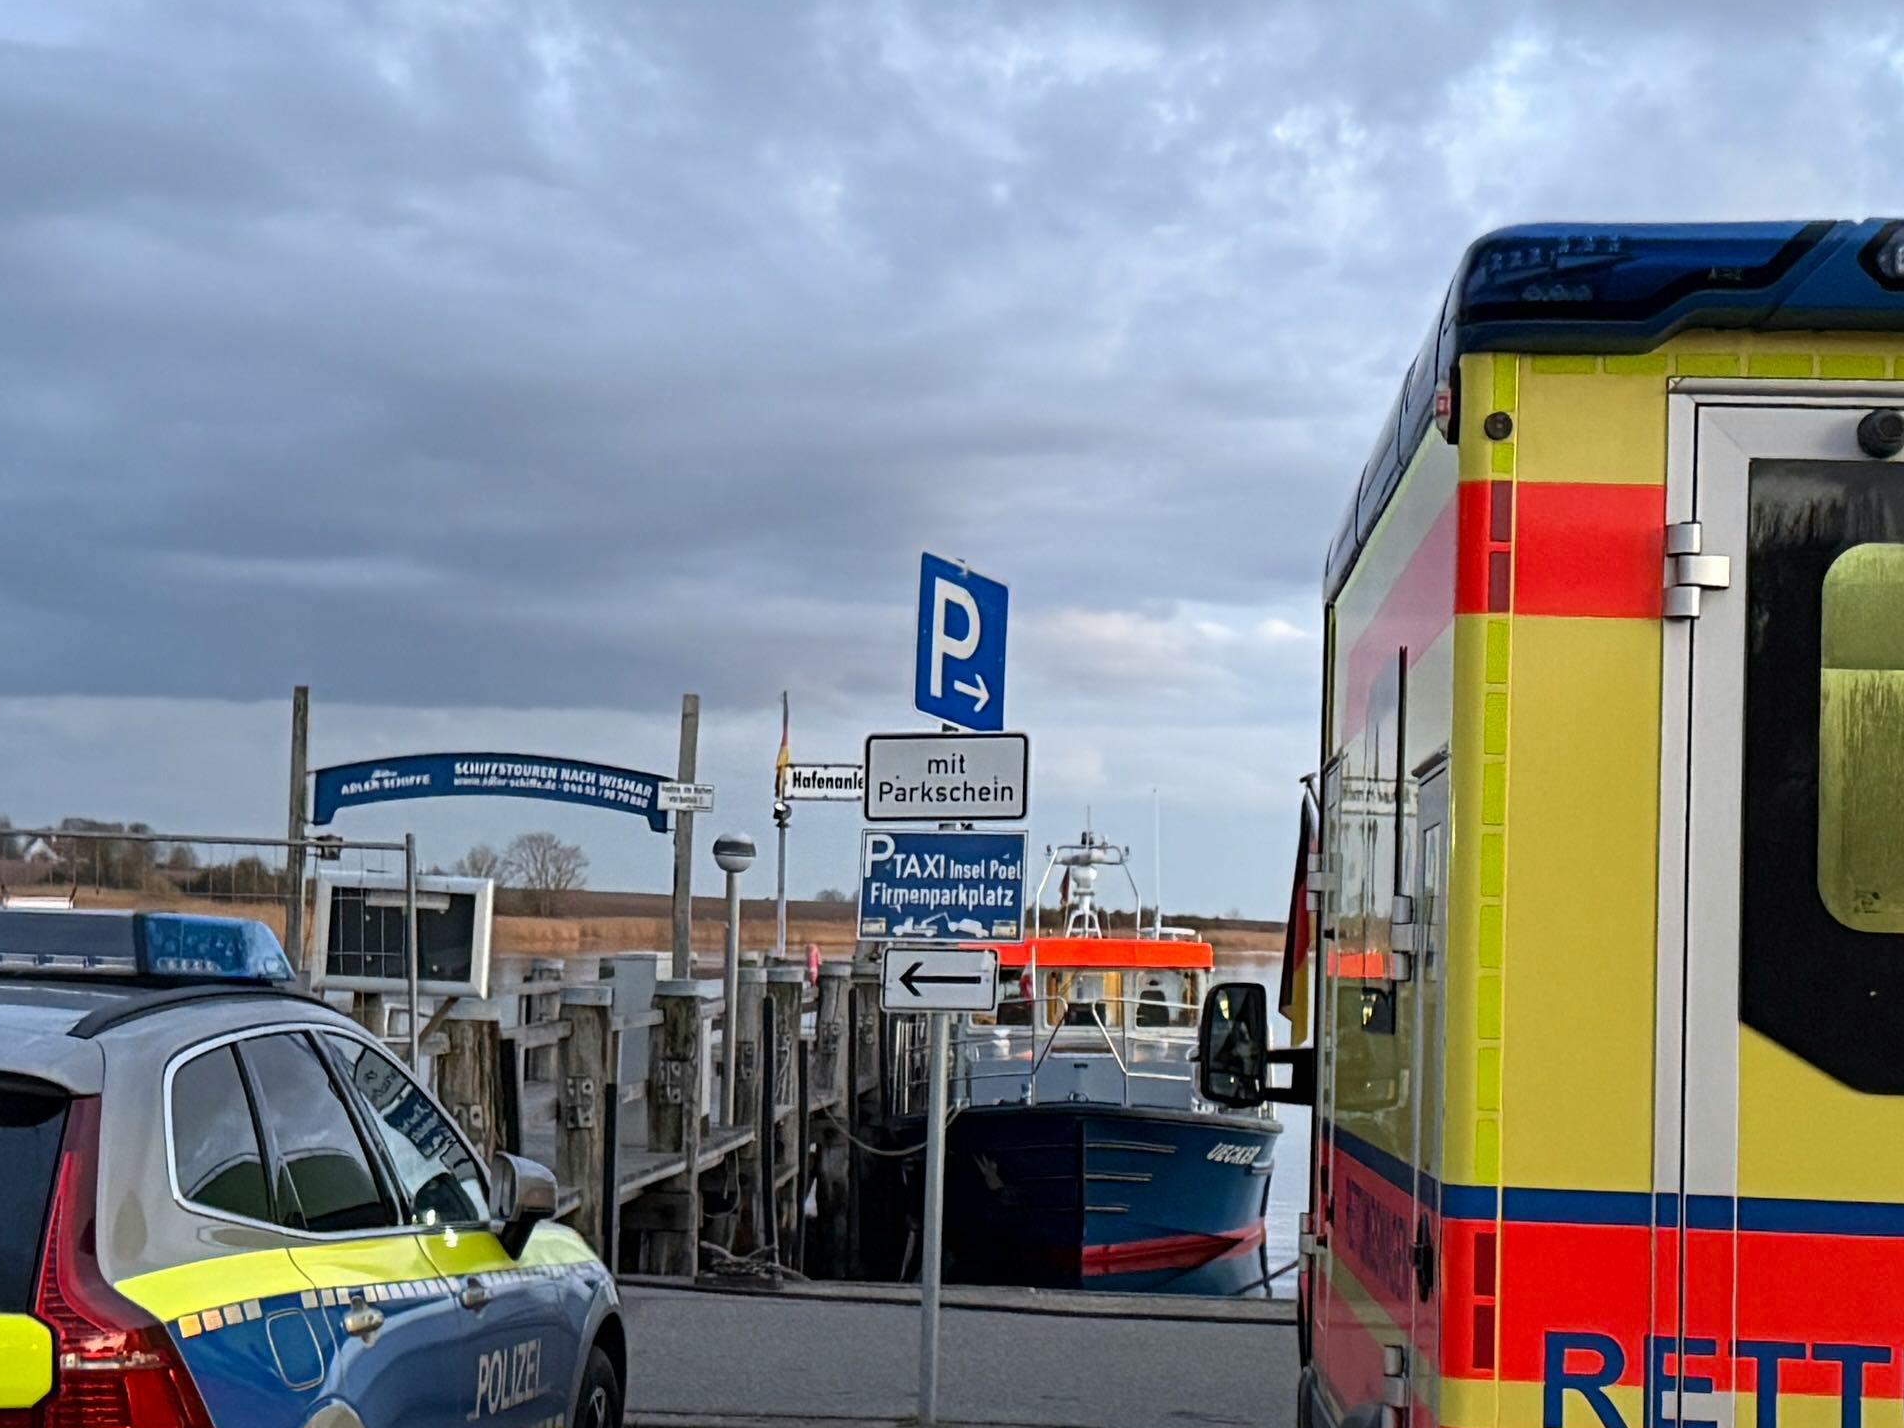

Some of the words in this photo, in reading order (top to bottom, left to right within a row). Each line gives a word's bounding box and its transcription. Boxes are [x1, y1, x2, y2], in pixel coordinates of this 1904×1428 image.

[929, 576, 981, 699] P
[454, 762, 558, 780] SCHIFFSTOUREN
[560, 767, 596, 784] NACH
[599, 773, 653, 799] WISMAR
[792, 770, 864, 790] Hafenanle
[927, 753, 966, 775] mit
[879, 777, 1014, 803] Parkschein
[864, 834, 896, 879] P
[893, 853, 945, 879] TAXI
[949, 859, 986, 880] Insel
[990, 859, 1022, 881] Poel
[870, 882, 1015, 912] Firmenparkplatz
[475, 1338, 542, 1420] POLIZEI
